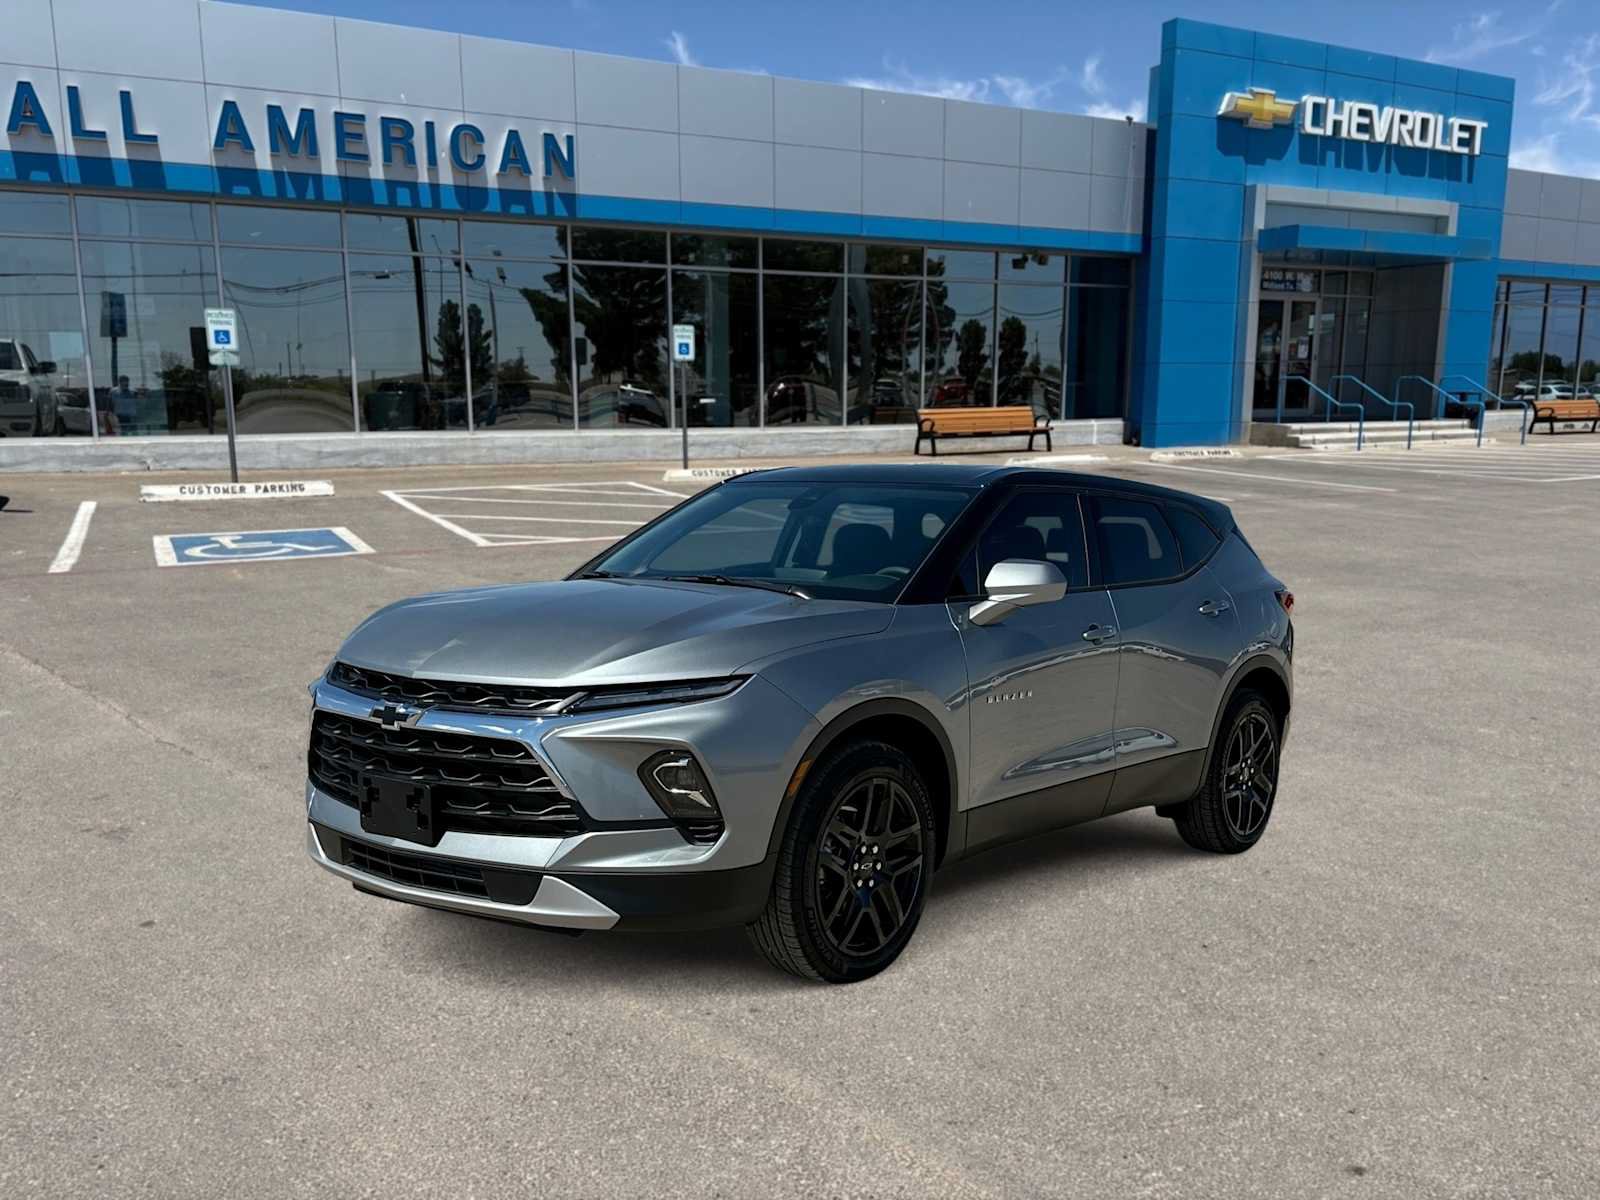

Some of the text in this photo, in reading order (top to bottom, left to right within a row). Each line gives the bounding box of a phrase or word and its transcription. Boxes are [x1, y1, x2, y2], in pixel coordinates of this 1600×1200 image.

[6, 80, 576, 178] ALL AMERICAN
[1302, 94, 1488, 156] CHEVROLET
[179, 483, 305, 495] CUSTOMER PARKING
